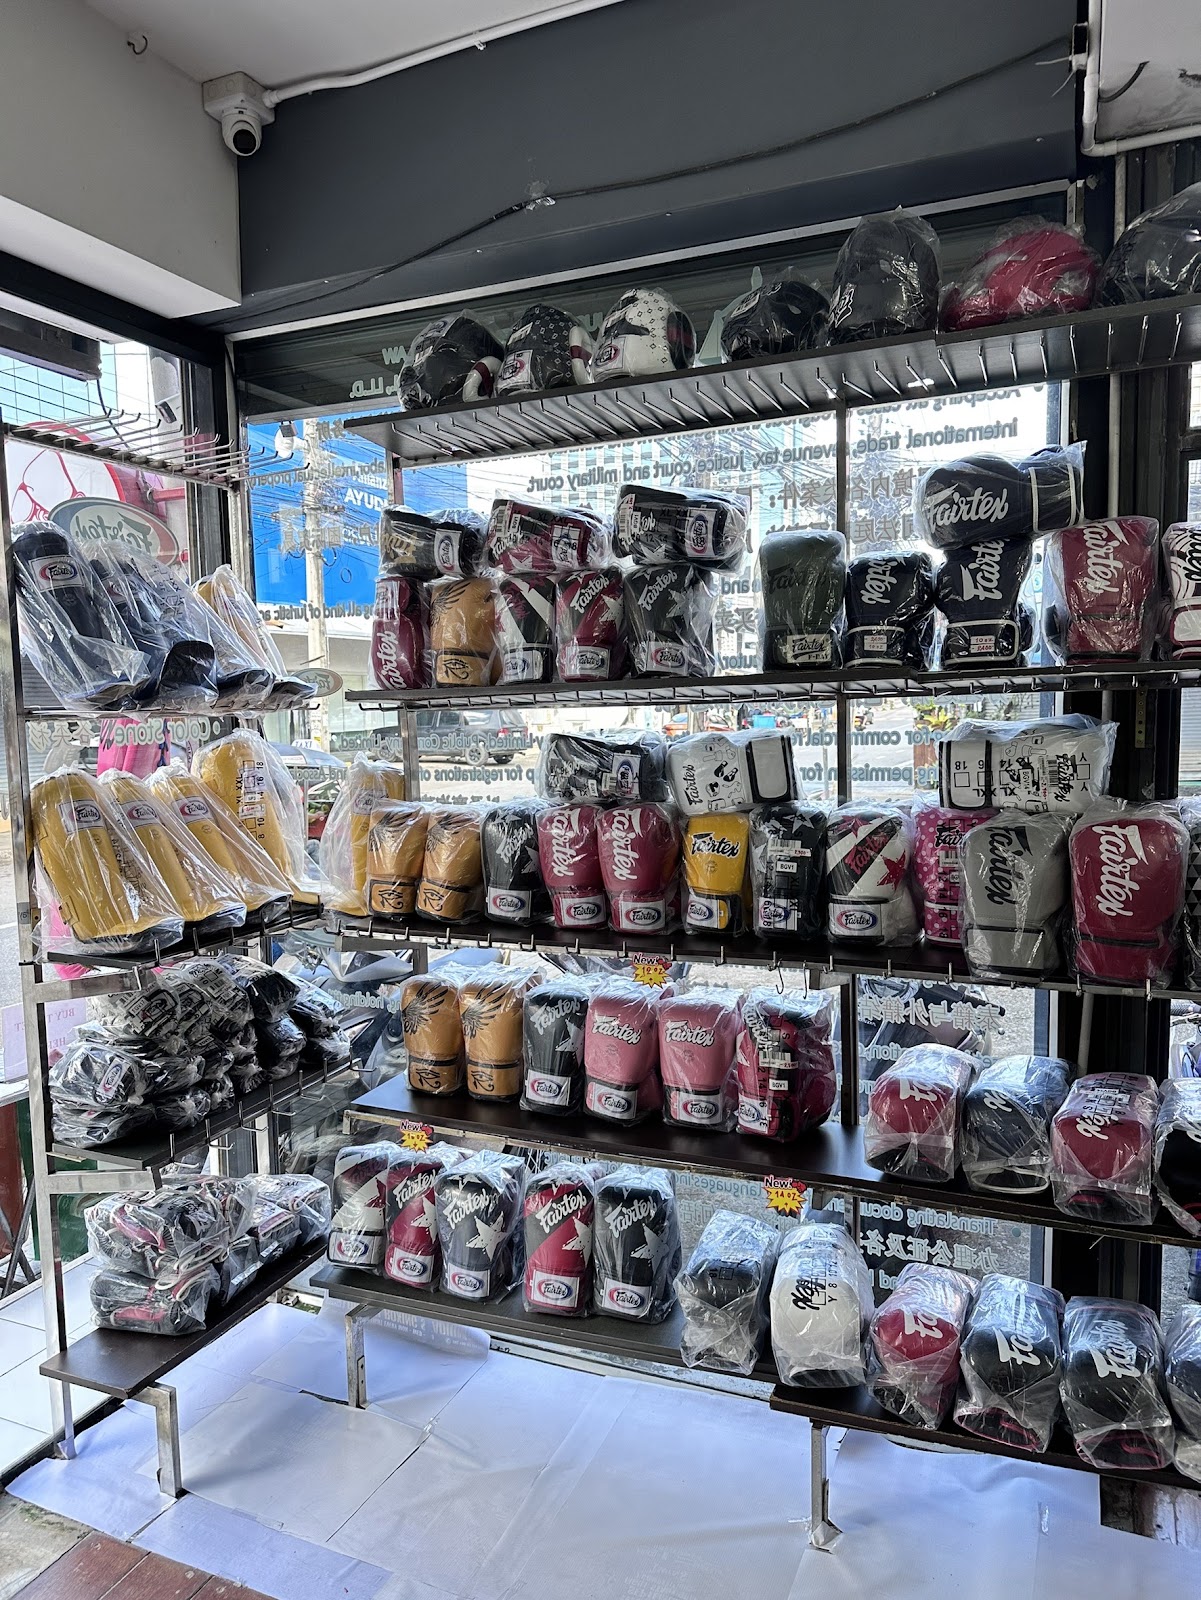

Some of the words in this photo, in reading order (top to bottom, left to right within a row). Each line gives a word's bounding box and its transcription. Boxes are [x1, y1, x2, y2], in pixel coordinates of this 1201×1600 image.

[344, 488, 388, 511] AYUD
[921, 483, 1009, 534] Fairtex
[570, 574, 609, 613] Fairtex
[638, 570, 678, 611] Fairtex
[256, 761, 264, 770] 18
[954, 760, 967, 770] 18
[256, 776, 264, 786] 16
[682, 765, 703, 806] Fairtex
[257, 817, 265, 827] 10
[552, 807, 583, 877] Fairtex
[612, 807, 643, 881] Fairtex
[691, 831, 740, 858] Fairtex
[844, 829, 888, 876] Fairtex
[985, 826, 1033, 905] Fairtex
[1092, 824, 1148, 917] Fairtex
[572, 903, 596, 918] Fairtex
[632, 908, 657, 924] Fairtex
[844, 910, 872, 927] Fairtex
[530, 999, 581, 1035] Fairtex
[591, 1015, 642, 1045] Fairtex
[664, 1020, 715, 1048] Fairtex
[534, 1081, 559, 1093] Fairtex
[602, 1096, 628, 1111] Fairtex
[687, 1101, 715, 1118] Fairtex
[393, 1171, 438, 1208] Fairtex
[775, 1190, 785, 1198] 14
[444, 1187, 489, 1230] Fairtex
[535, 1188, 587, 1234] Fairtex
[604, 1195, 657, 1239] Fairtex
[401, 1259, 425, 1276] Fairtex
[457, 1273, 479, 1290] Fairtex
[544, 1281, 568, 1299] Fairtex
[615, 1291, 640, 1309] Fairtex
